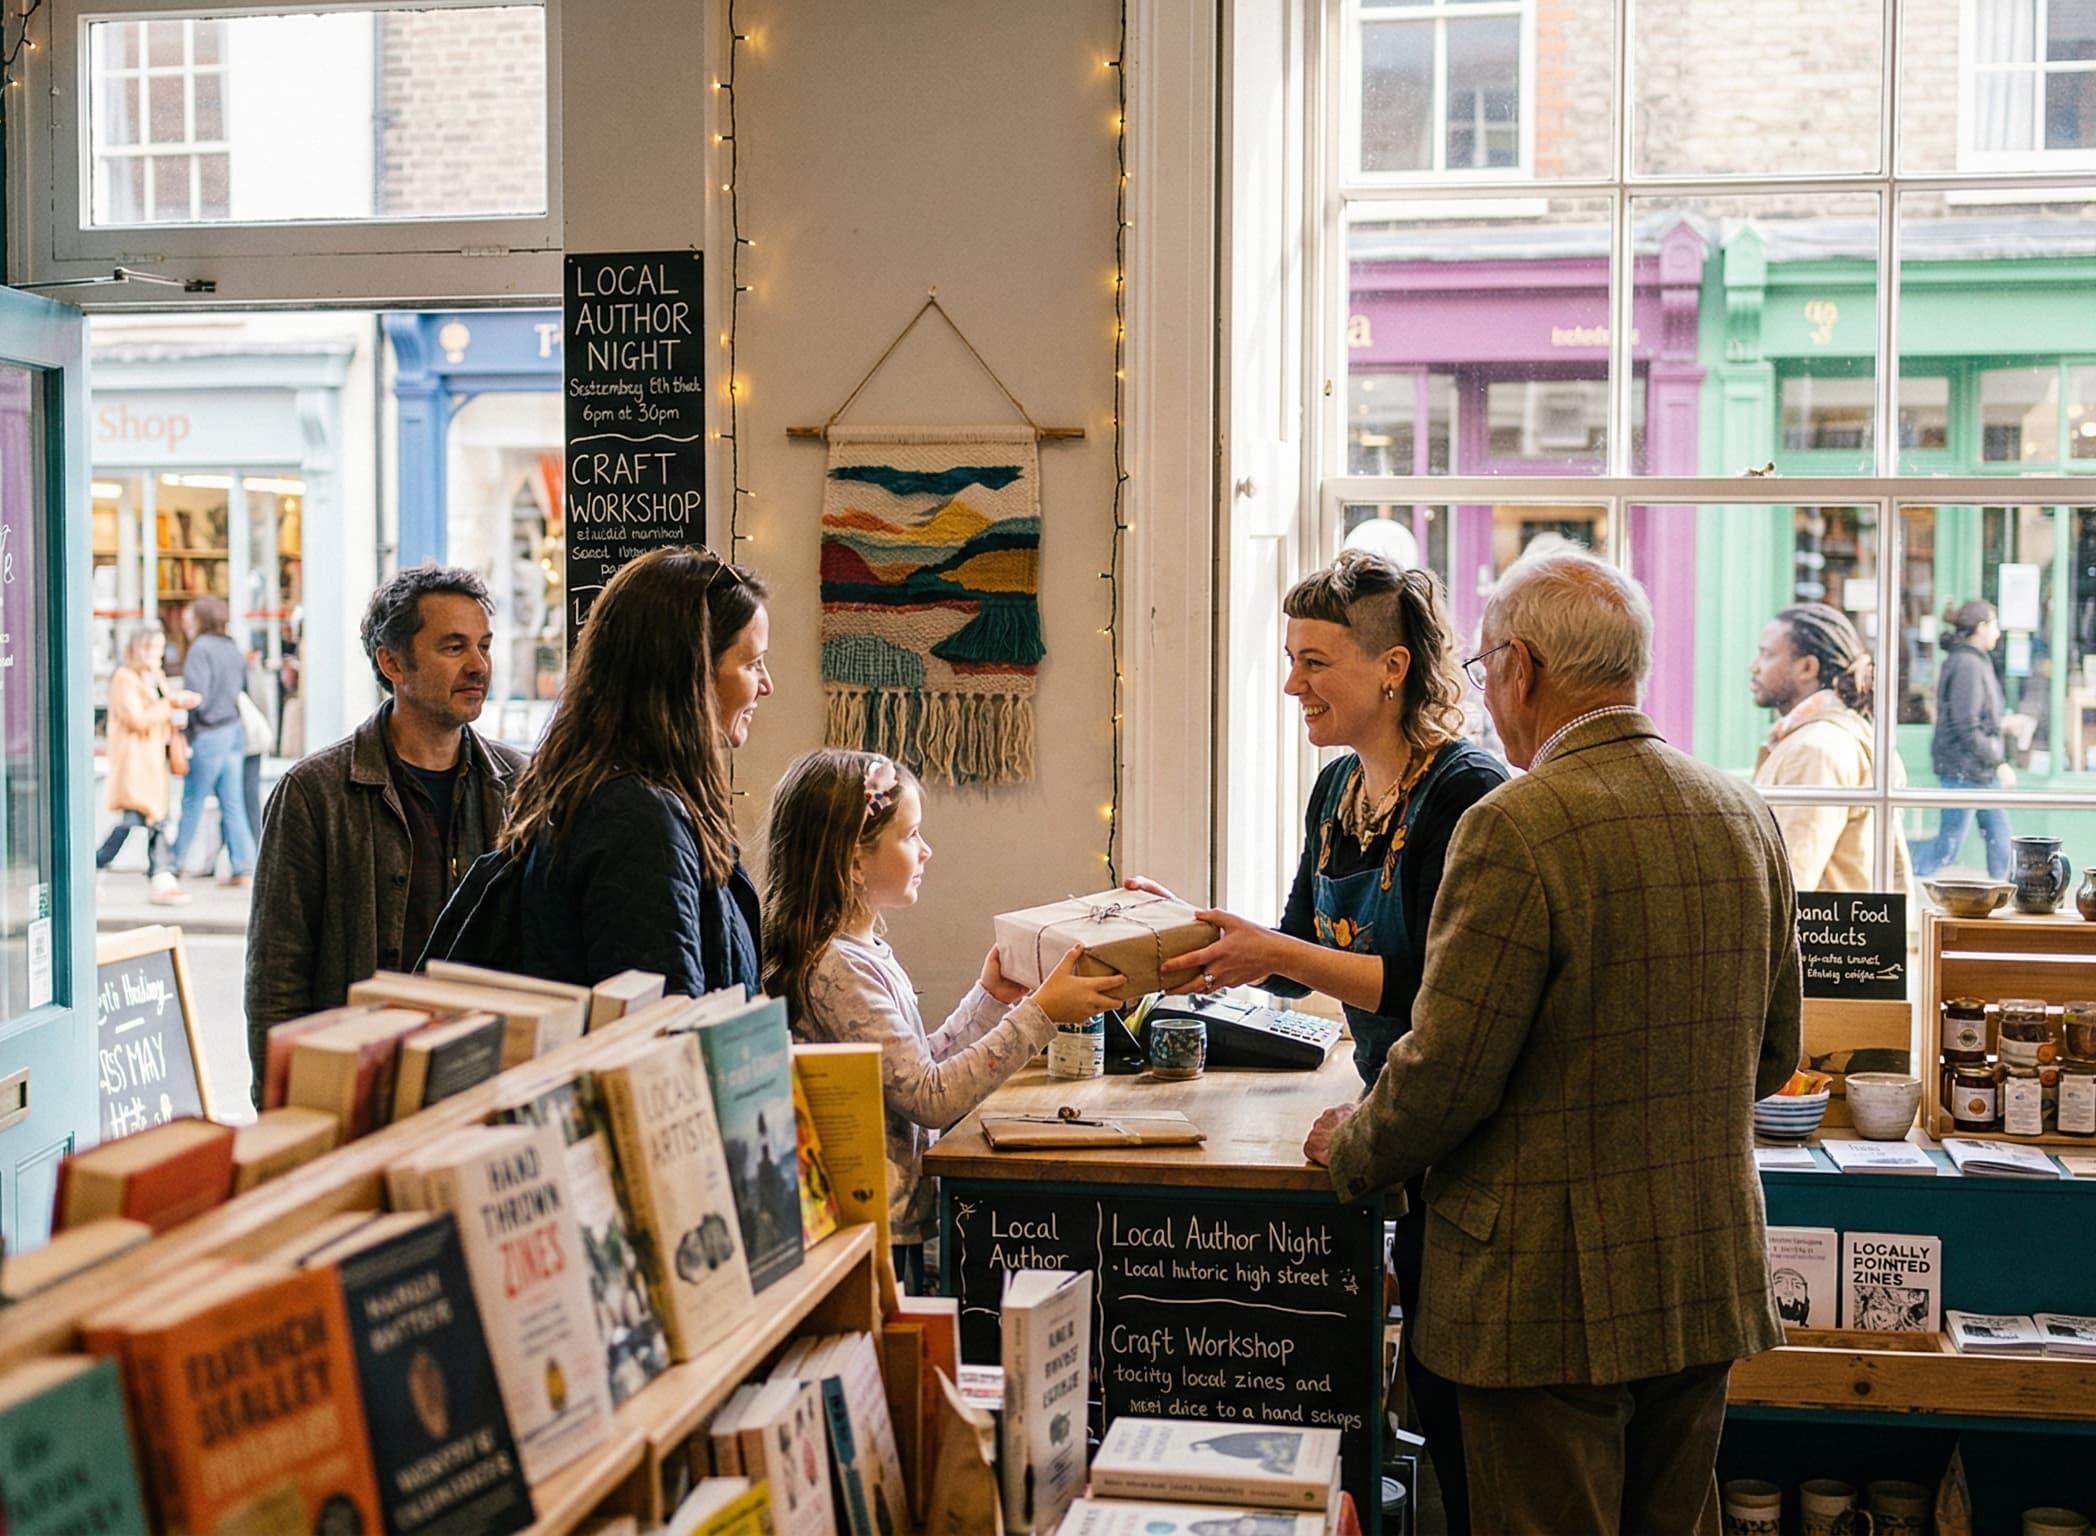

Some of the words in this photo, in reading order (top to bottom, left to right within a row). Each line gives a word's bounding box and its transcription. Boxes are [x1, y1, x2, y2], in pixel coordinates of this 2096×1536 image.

[577, 264, 680, 297] LOCAL
[575, 302, 692, 336] AUTHOR
[588, 339, 681, 371] NIGHT
[98, 402, 192, 453] Shop
[583, 404, 615, 428] 6pm
[618, 404, 632, 420] at
[638, 403, 680, 426] 30pm
[571, 452, 677, 485] CRAFT
[570, 490, 702, 524] WORKSHOP
[1851, 901, 1891, 923] Food
[1798, 926, 1867, 946] roducts
[126, 1032, 167, 1089] MAY
[991, 1210, 1060, 1240] Local
[1112, 1212, 1175, 1249] Local
[1185, 1215, 1262, 1251] Author
[1268, 1220, 1332, 1265] Night
[989, 1243, 1069, 1269] Author
[1853, 1242, 1930, 1259] LOCALLY
[1124, 1257, 1165, 1278] Local
[1236, 1262, 1271, 1292] high
[1277, 1266, 1329, 1286] street
[1852, 1271, 1903, 1286] ZINES
[1111, 1324, 1175, 1362] Craft
[1185, 1327, 1295, 1367] Workshop
[1182, 1365, 1227, 1389] local
[1234, 1371, 1286, 1391] zines
[1296, 1374, 1332, 1393] and
[1216, 1401, 1236, 1418] to
[1242, 1407, 1255, 1420] a
[1262, 1402, 1304, 1422] hand
